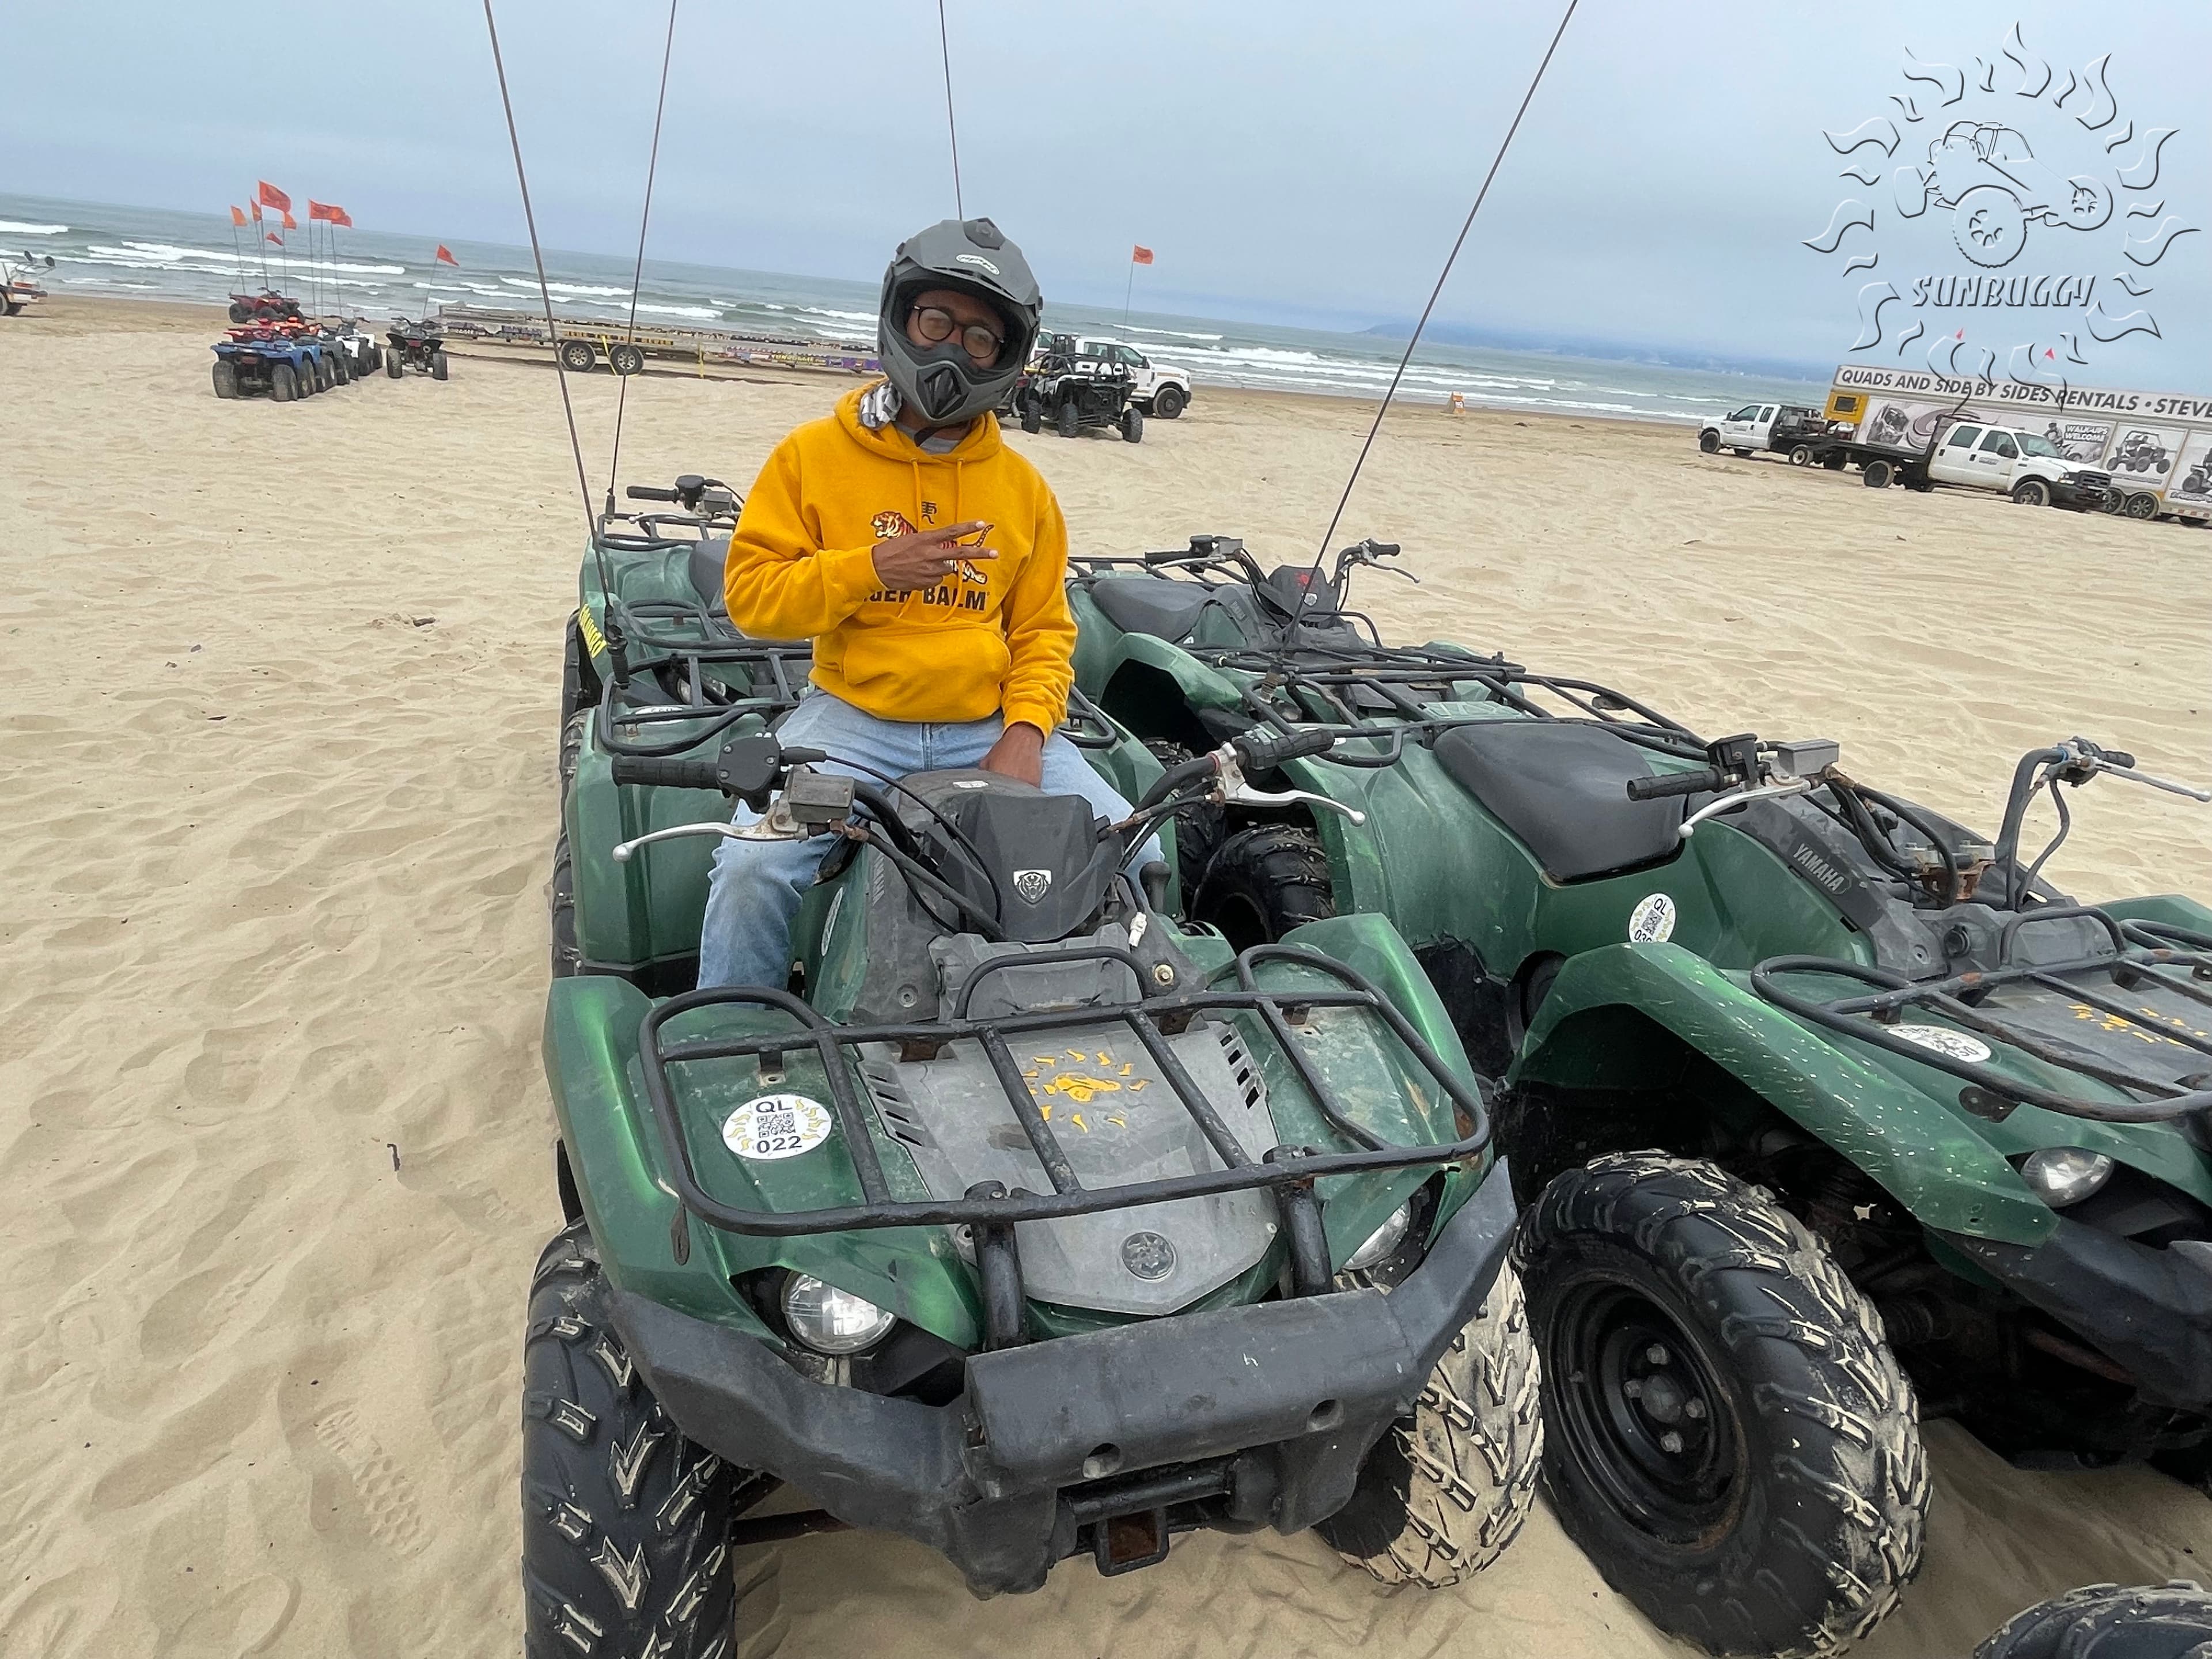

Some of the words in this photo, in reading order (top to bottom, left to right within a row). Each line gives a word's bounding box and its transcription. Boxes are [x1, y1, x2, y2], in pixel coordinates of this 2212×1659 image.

[1842, 369, 1893, 387] QUADS
[1895, 374, 1930, 391] AND
[1934, 379, 1972, 394] SIDE
[1974, 382, 1998, 397] BY
[1999, 384, 2051, 402] SIDES
[2056, 389, 2139, 411] RENTALS
[1793, 843, 1844, 891] YAMAHA
[1654, 898, 1665, 916] QL
[756, 1100, 793, 1113] QL
[756, 1135, 802, 1153] 022
